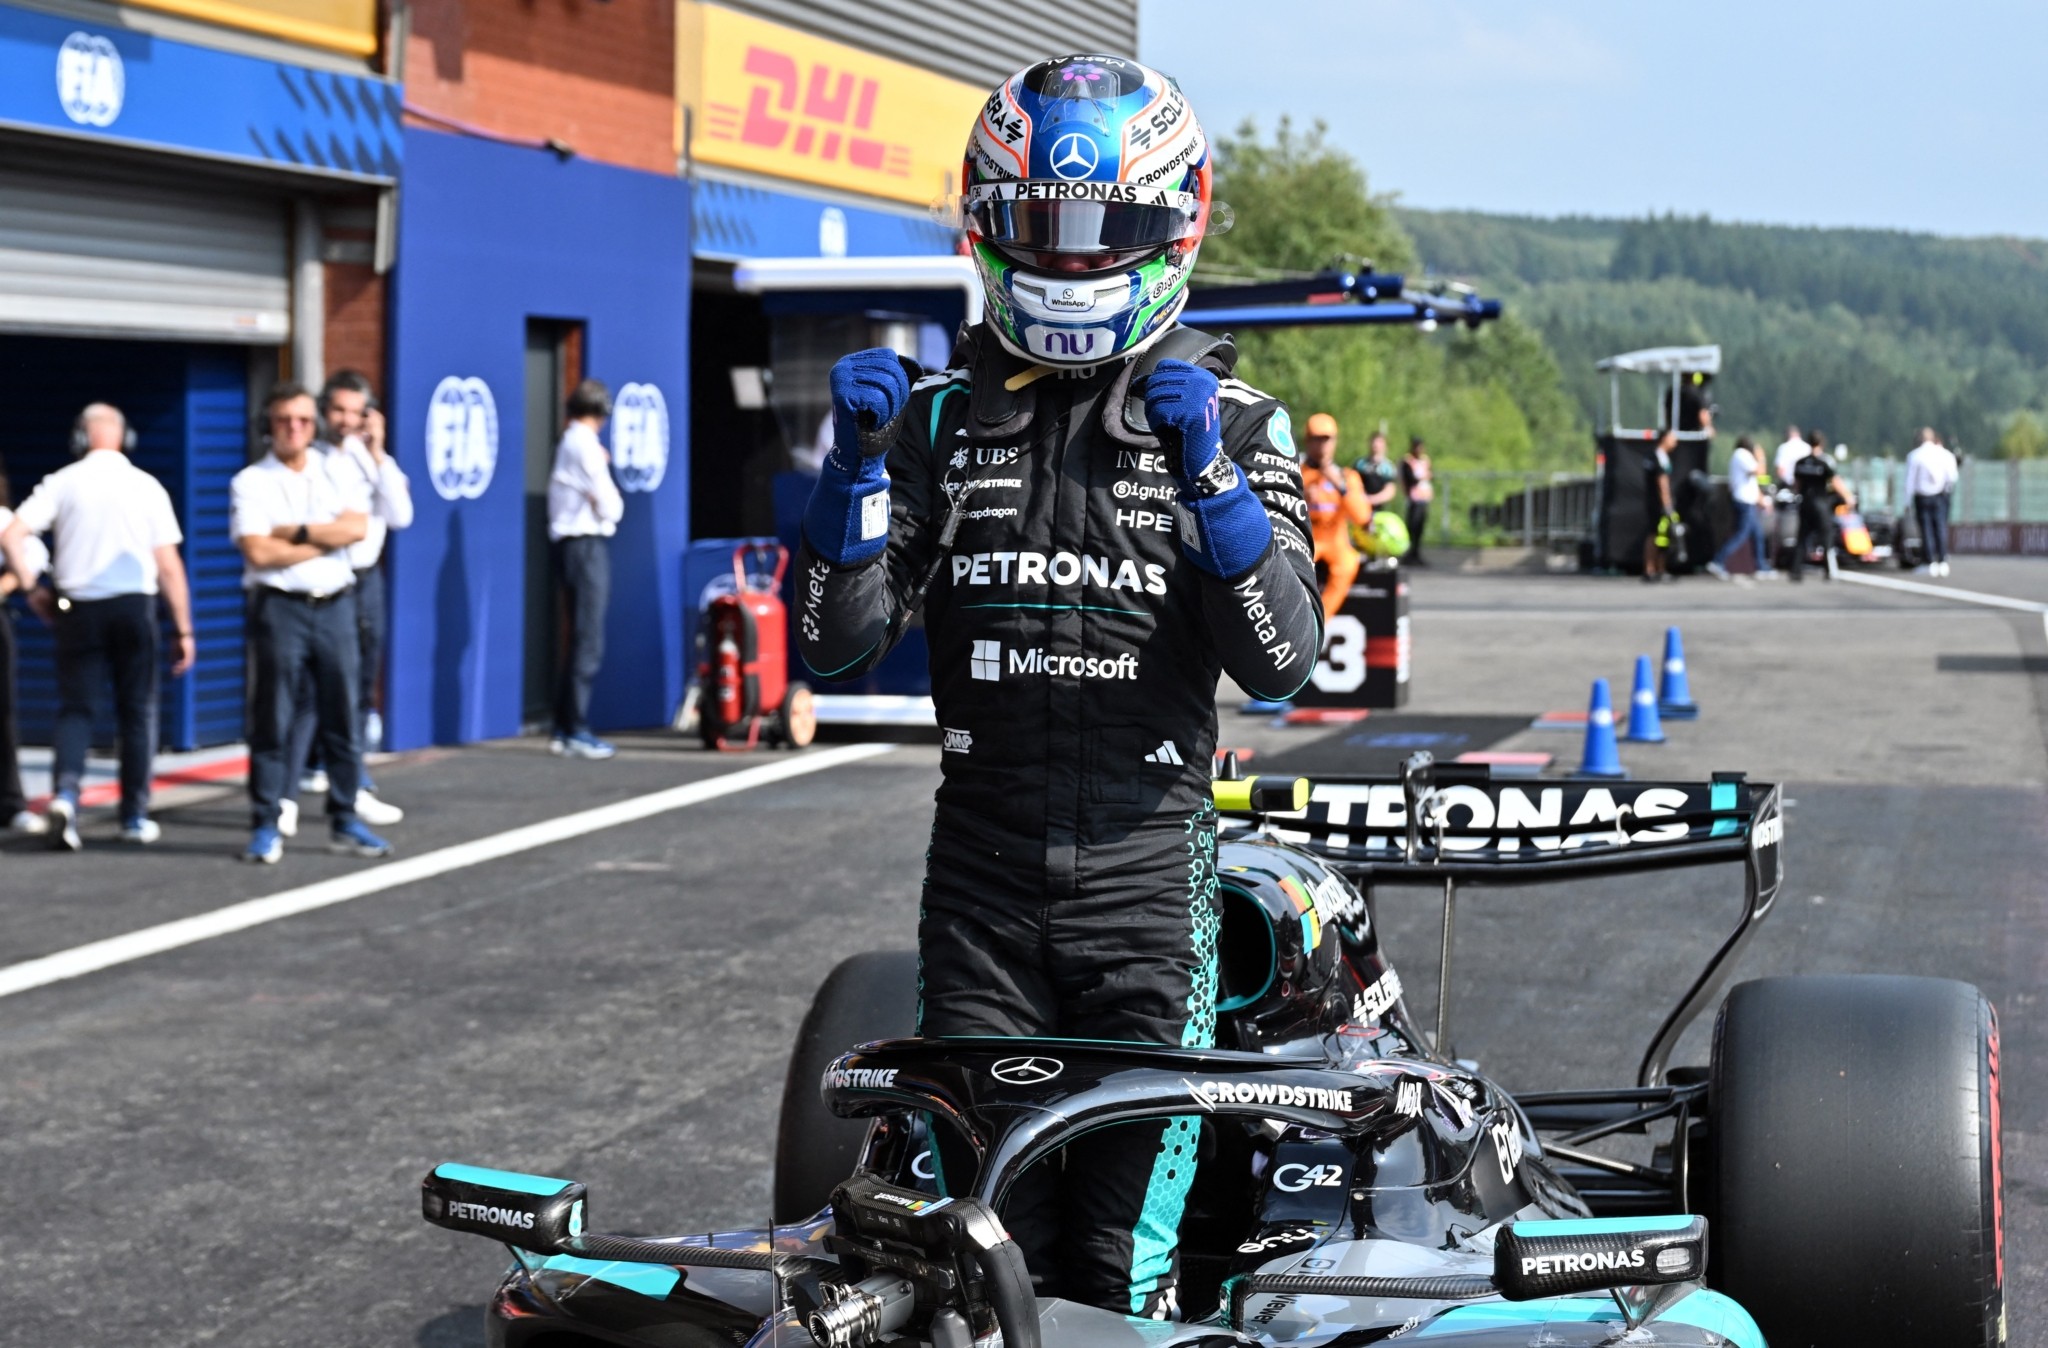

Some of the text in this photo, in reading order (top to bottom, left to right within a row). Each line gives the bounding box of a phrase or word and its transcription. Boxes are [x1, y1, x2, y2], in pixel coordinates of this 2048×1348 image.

[740, 45, 885, 170] DHL
[1138, 137, 1198, 186] CROWDSTRIKE
[1015, 182, 1137, 203] PETRONAS
[1051, 299, 1086, 308] WhatsApp
[1045, 332, 1094, 355] nu
[976, 446, 1018, 465] UBS
[961, 507, 1017, 520] Snapdragon
[1265, 490, 1307, 520] IWC
[1116, 508, 1173, 532] HPE
[952, 551, 1167, 595] PETRONAS
[1235, 576, 1297, 671] Meta AI
[1009, 648, 1138, 680] Microsoft
[1310, 614, 1366, 692] 3
[944, 731, 973, 749] OMP
[1201, 1081, 1352, 1111] CROWDSTRIKE
[1273, 1163, 1343, 1192] G42
[449, 1200, 535, 1230] PETRONAS
[1522, 1249, 1645, 1276] PETRONAS
